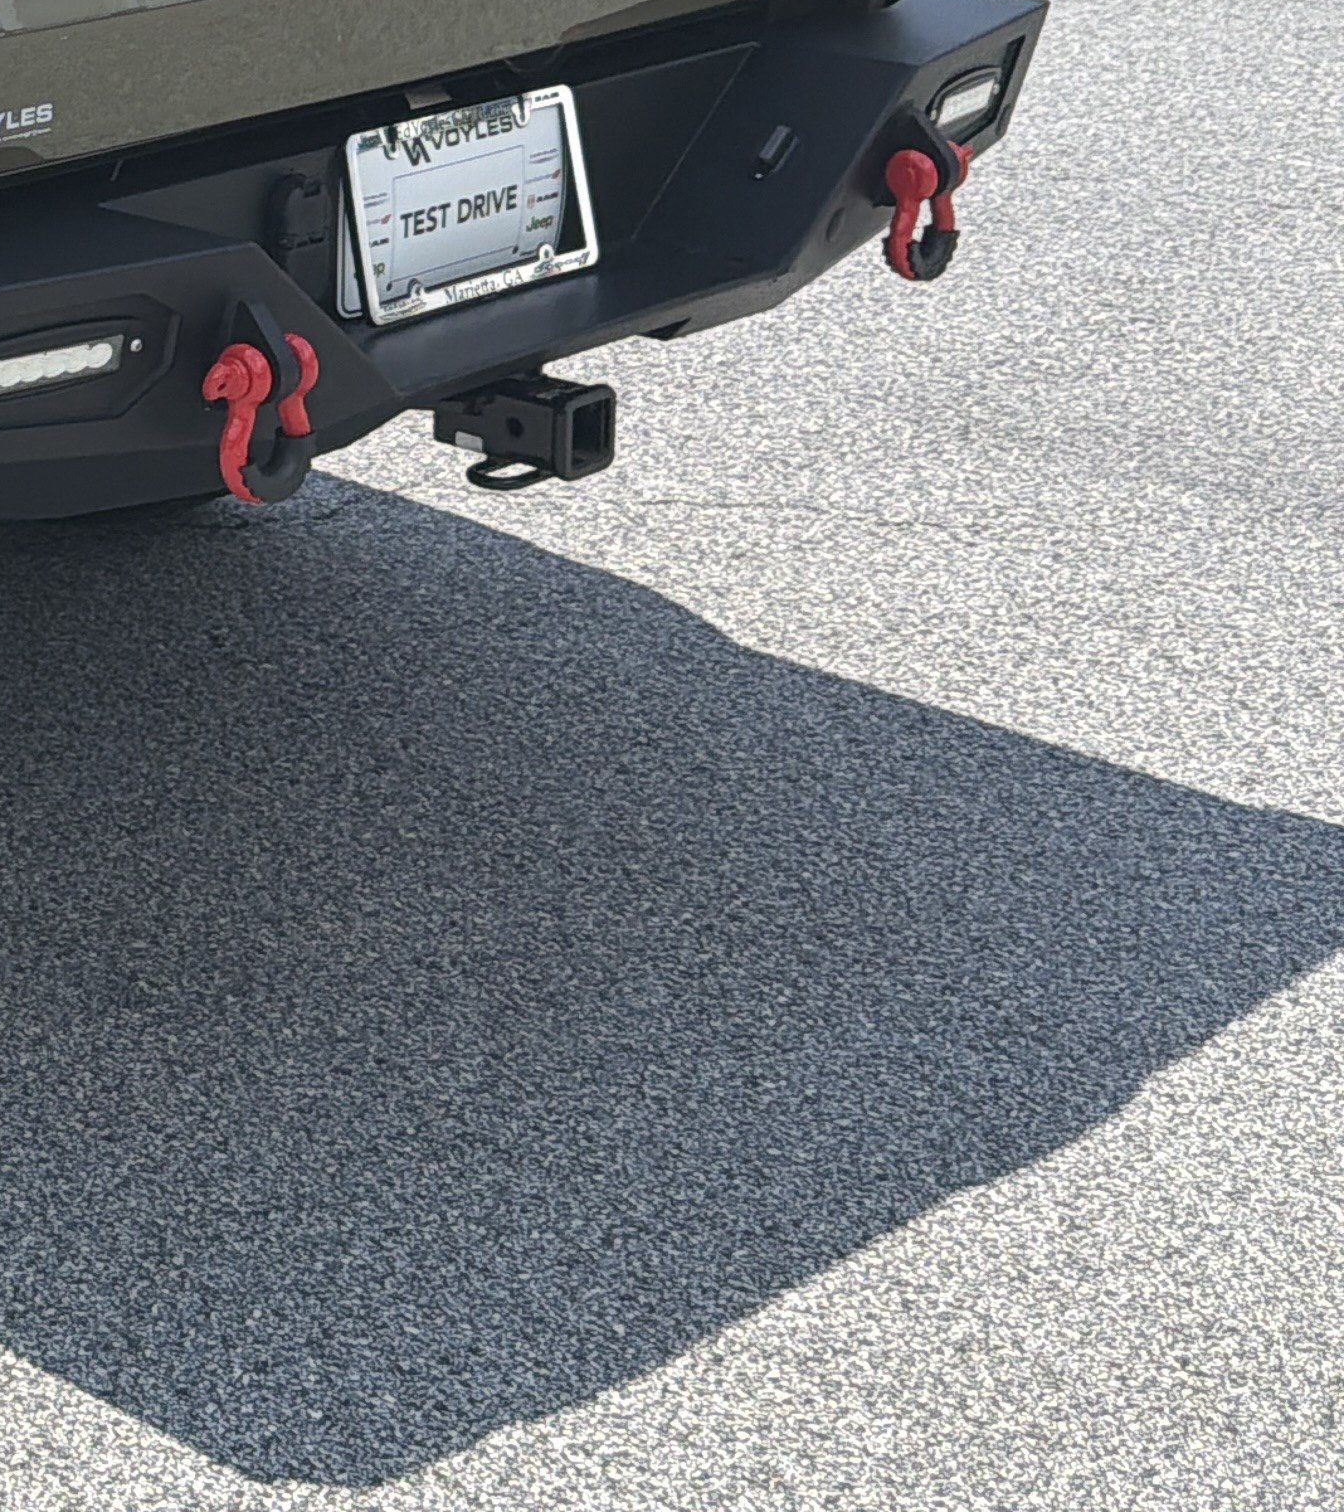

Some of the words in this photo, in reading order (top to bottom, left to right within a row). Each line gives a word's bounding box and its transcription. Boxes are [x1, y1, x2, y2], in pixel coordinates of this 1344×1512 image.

[430, 115, 515, 151] VOYLES
[400, 201, 451, 239] TEST
[456, 183, 518, 225] DRIVE
[525, 215, 554, 234] Jeep
[503, 269, 524, 292] GA
